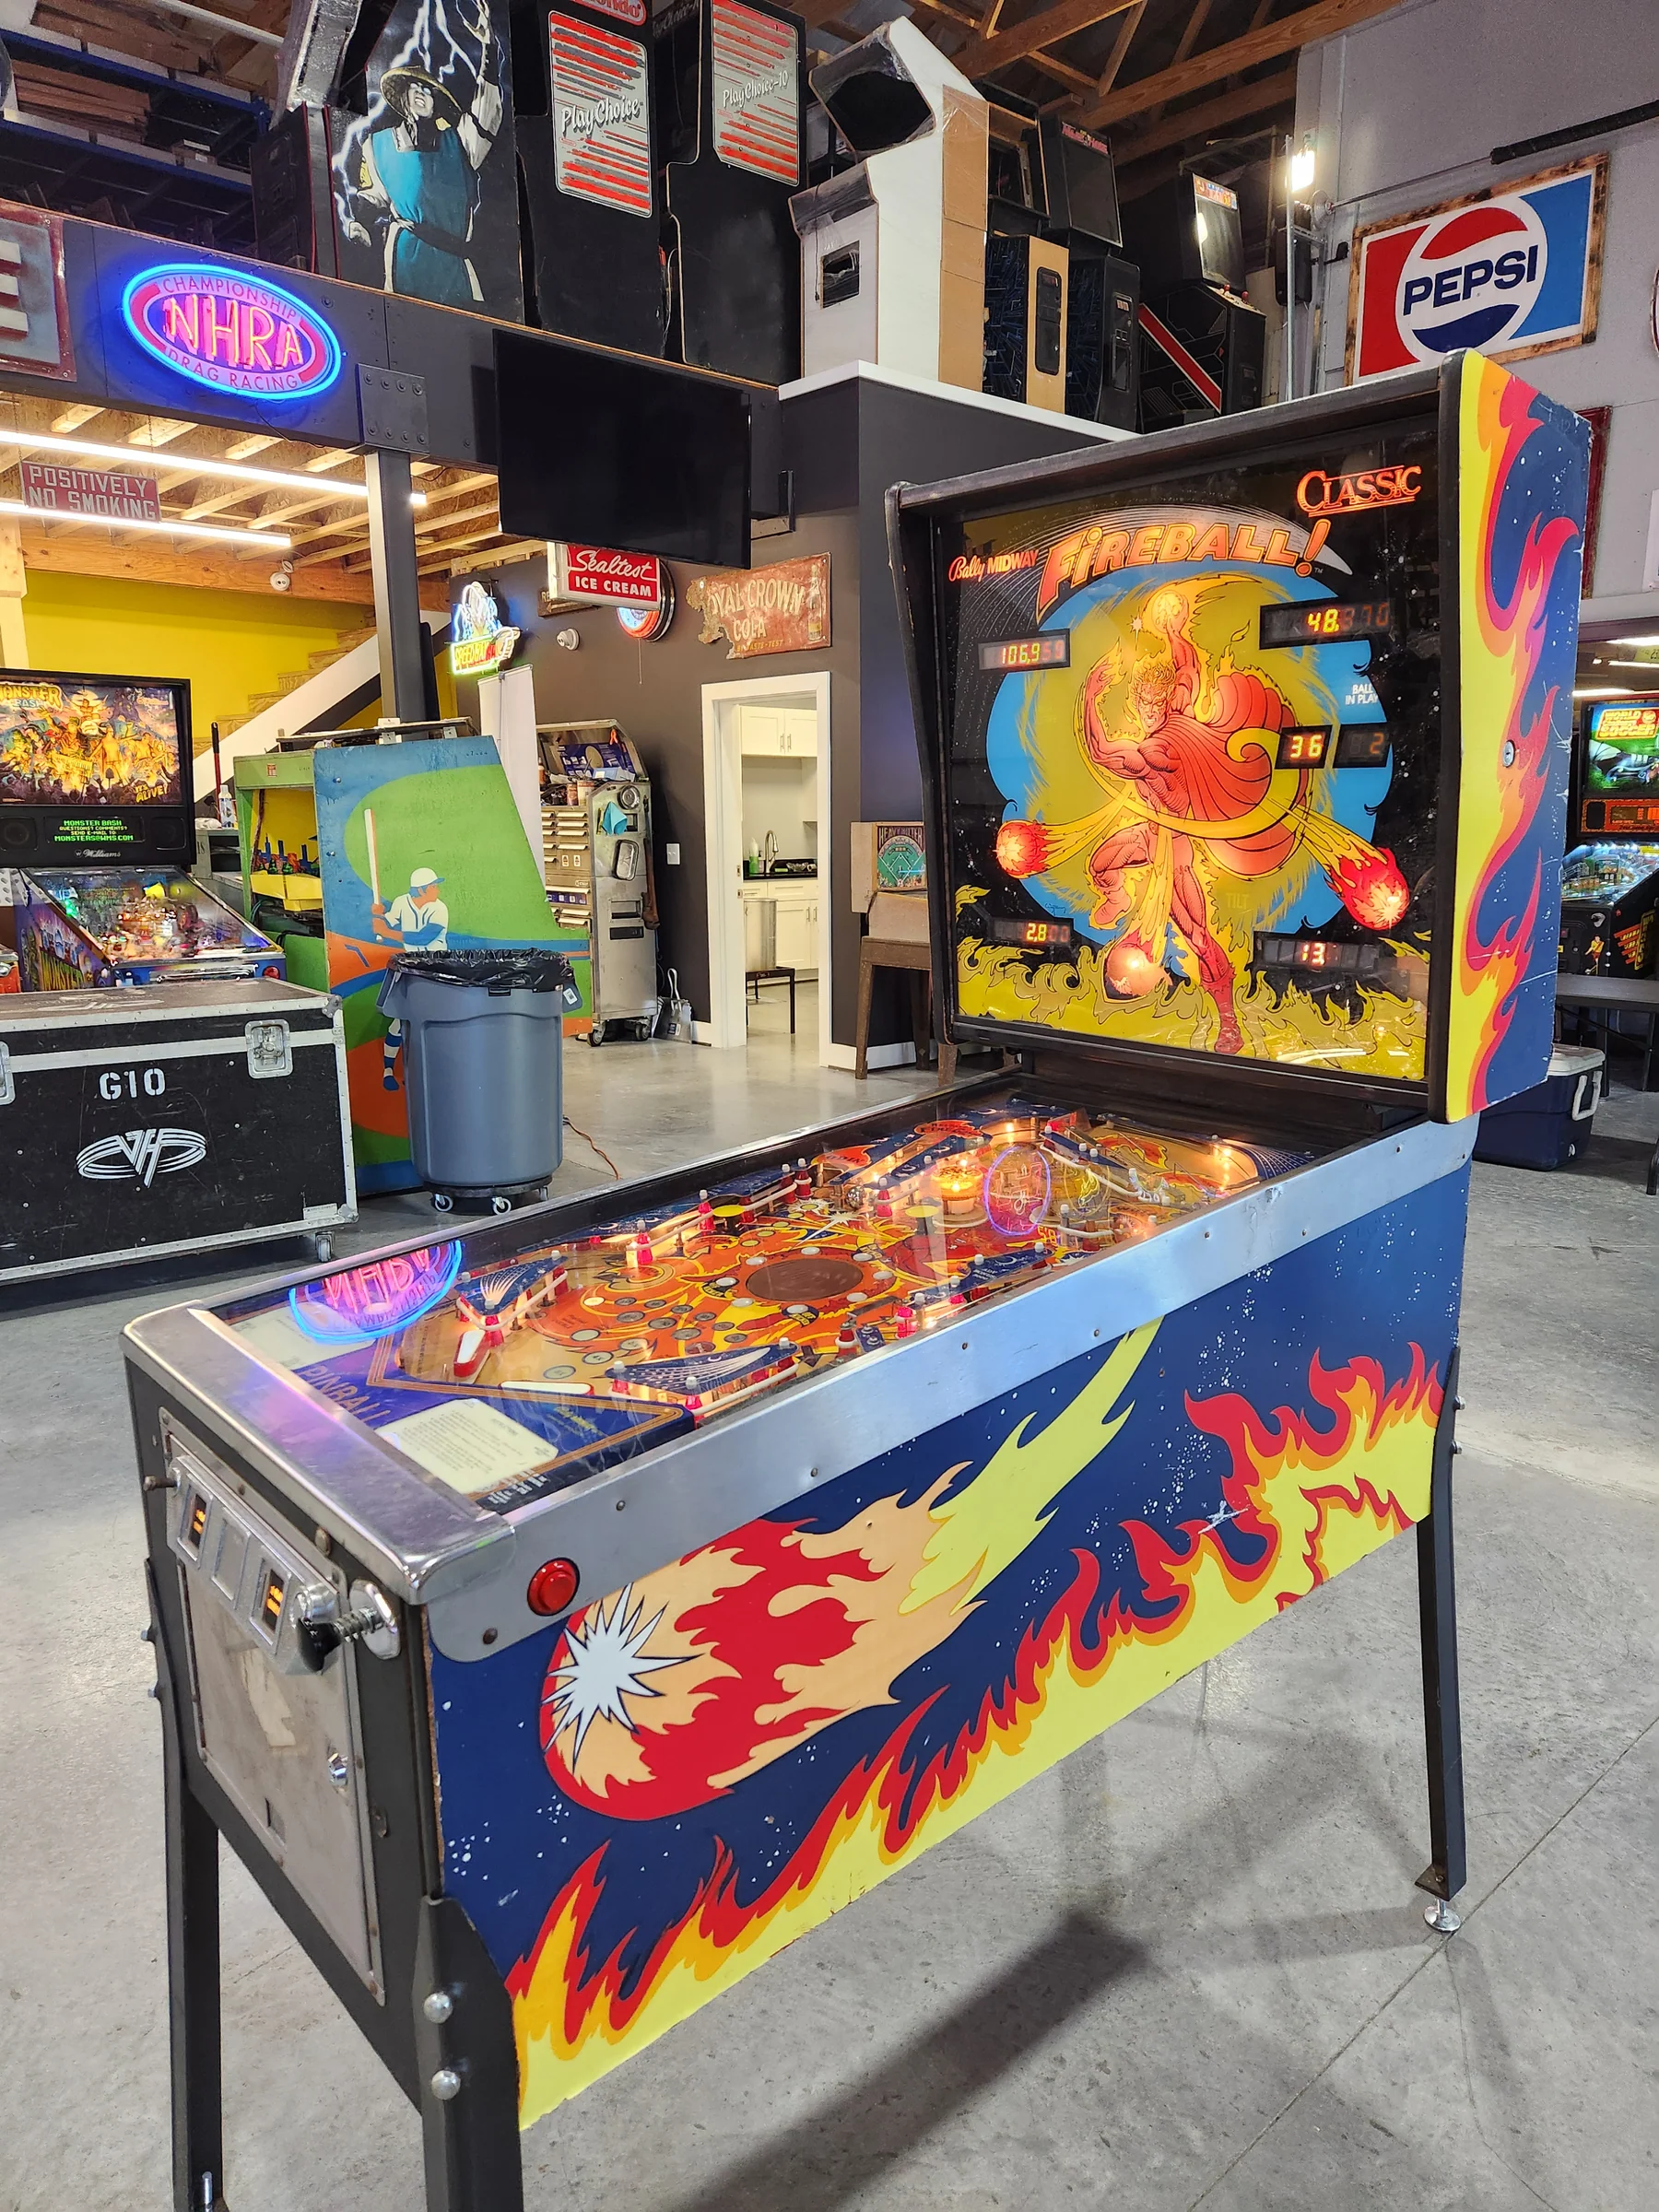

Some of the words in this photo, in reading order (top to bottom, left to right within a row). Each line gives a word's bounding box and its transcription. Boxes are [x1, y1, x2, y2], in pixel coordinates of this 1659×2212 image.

[723, 70, 789, 108] PlayChoice-10
[561, 96, 640, 136] PlayChoice
[1403, 244, 1538, 316] PEPSI
[163, 276, 297, 320] CHAMPIONSHIP
[163, 293, 304, 371] NHRA
[167, 347, 219, 382] DRAG
[229, 372, 299, 391] RACING
[29, 465, 147, 497] POSITIVELY
[29, 487, 56, 509] NO
[68, 491, 156, 521] SMOKING
[576, 549, 652, 579] Sealtest
[948, 555, 985, 582] Bally
[987, 548, 1039, 574] MIDWAY
[575, 575, 597, 590] ICE
[603, 580, 652, 597] CREAM
[747, 578, 806, 616] CROWN
[733, 615, 767, 641] COLA
[1346, 695, 1355, 704] IN
[1358, 694, 1379, 704] PLAY
[1352, 684, 1374, 694] BALL
[1290, 735, 1323, 759] 36
[83, 849, 121, 858] Williams
[1226, 893, 1250, 908] TILT
[99, 1067, 166, 1100] G10
